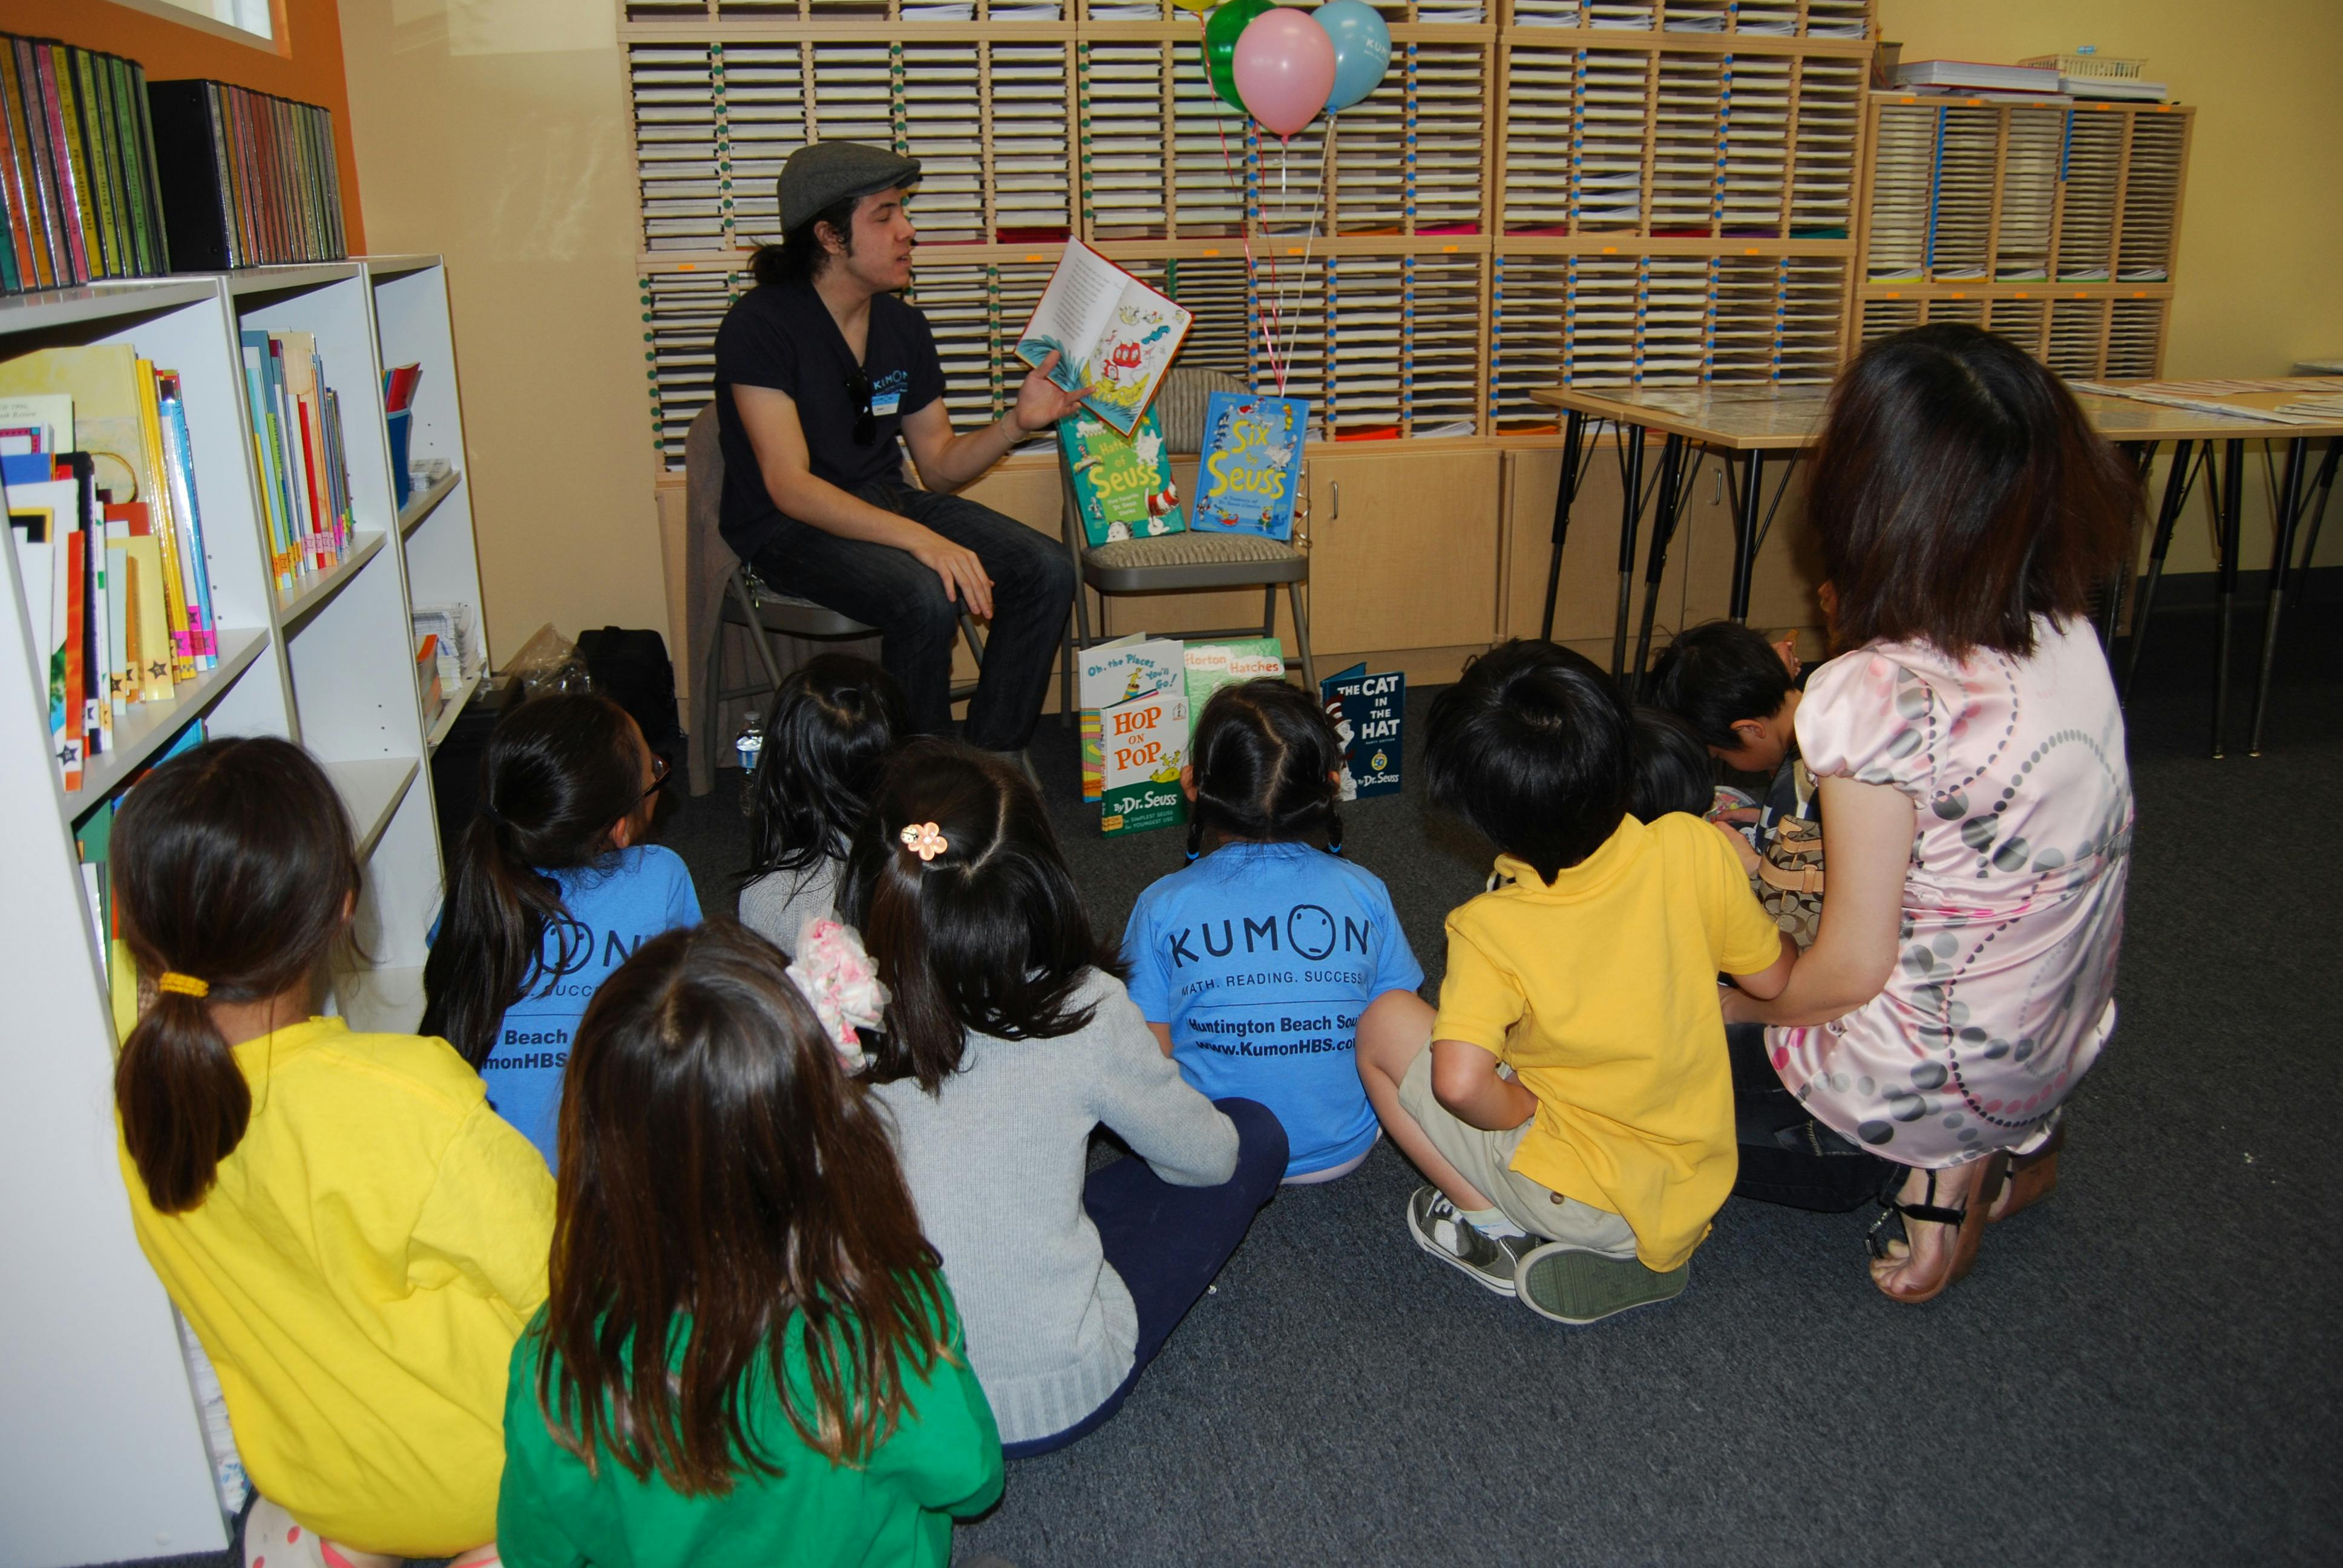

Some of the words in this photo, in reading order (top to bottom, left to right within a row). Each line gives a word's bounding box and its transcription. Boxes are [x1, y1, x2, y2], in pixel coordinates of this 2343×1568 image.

[1231, 419, 1269, 453] Six
[1114, 455, 1126, 468] of
[1246, 452, 1259, 465] by
[1089, 464, 1162, 498] Seuss
[1207, 449, 1287, 500] Seuss
[1108, 658, 1124, 668] the
[1126, 653, 1156, 668] Places
[1185, 653, 1227, 665] Horton
[1230, 661, 1279, 673] Hatches
[1145, 667, 1170, 680] You'll
[1156, 673, 1178, 689] Go!
[1337, 684, 1360, 696] THE
[1362, 676, 1399, 696] CAT
[1375, 697, 1388, 707] IN
[1113, 706, 1162, 736] HOP
[1369, 708, 1391, 719] THE
[1362, 719, 1401, 740] HAT
[1128, 734, 1145, 745] ON
[1114, 741, 1162, 771] POP
[1363, 775, 1377, 787] Dr.
[1377, 771, 1400, 784] Seuss
[1113, 803, 1125, 814] By
[1122, 797, 1144, 815] Dr.
[1144, 791, 1178, 809] Seuss
[1169, 904, 1369, 968] KUMON
[1181, 978, 1221, 996] MATH.
[1227, 972, 1298, 987] READING.
[1188, 1018, 1275, 1037] Huntington
[1280, 1015, 1331, 1033] Beach
[1337, 1014, 1361, 1030] Sou
[505, 1028, 568, 1045] Beach
